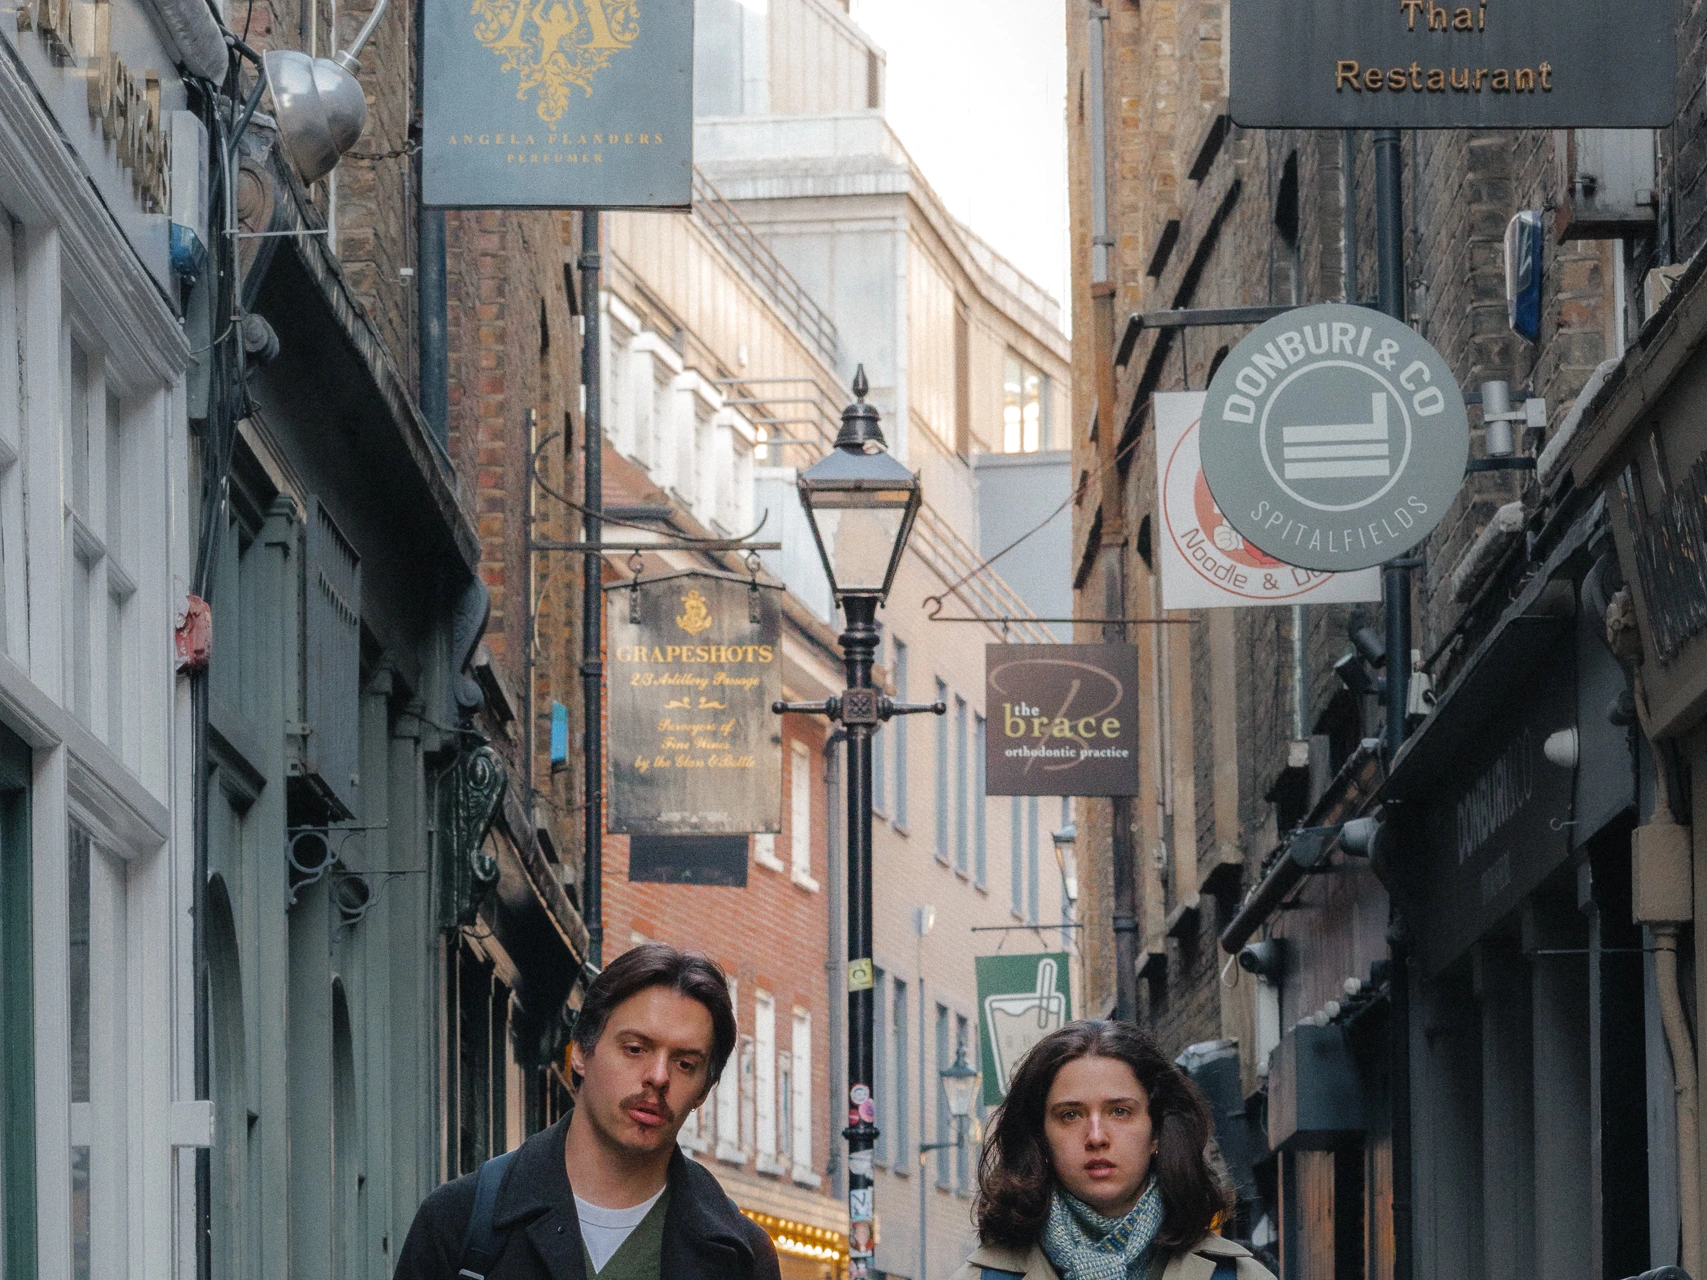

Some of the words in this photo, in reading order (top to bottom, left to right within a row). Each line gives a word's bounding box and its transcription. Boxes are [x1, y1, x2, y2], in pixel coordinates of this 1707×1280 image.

[1400, 0, 1487, 32] Thai
[1335, 59, 1552, 93] Restaurant
[449, 133, 535, 145] ANGELA
[548, 133, 664, 145] FLANDERS
[507, 153, 604, 163] PERFUMER
[1222, 321, 1372, 424] DONBURI
[1250, 495, 1428, 552] SPITALFIELDS
[1181, 527, 1249, 589] Noodle
[1262, 572, 1280, 590] &
[615, 645, 774, 663] GRAPESHOTS
[1002, 702, 1121, 738] brace
[1014, 701, 1040, 717] the
[1004, 745, 1077, 758] orthodontic
[1079, 745, 1130, 761] practice
